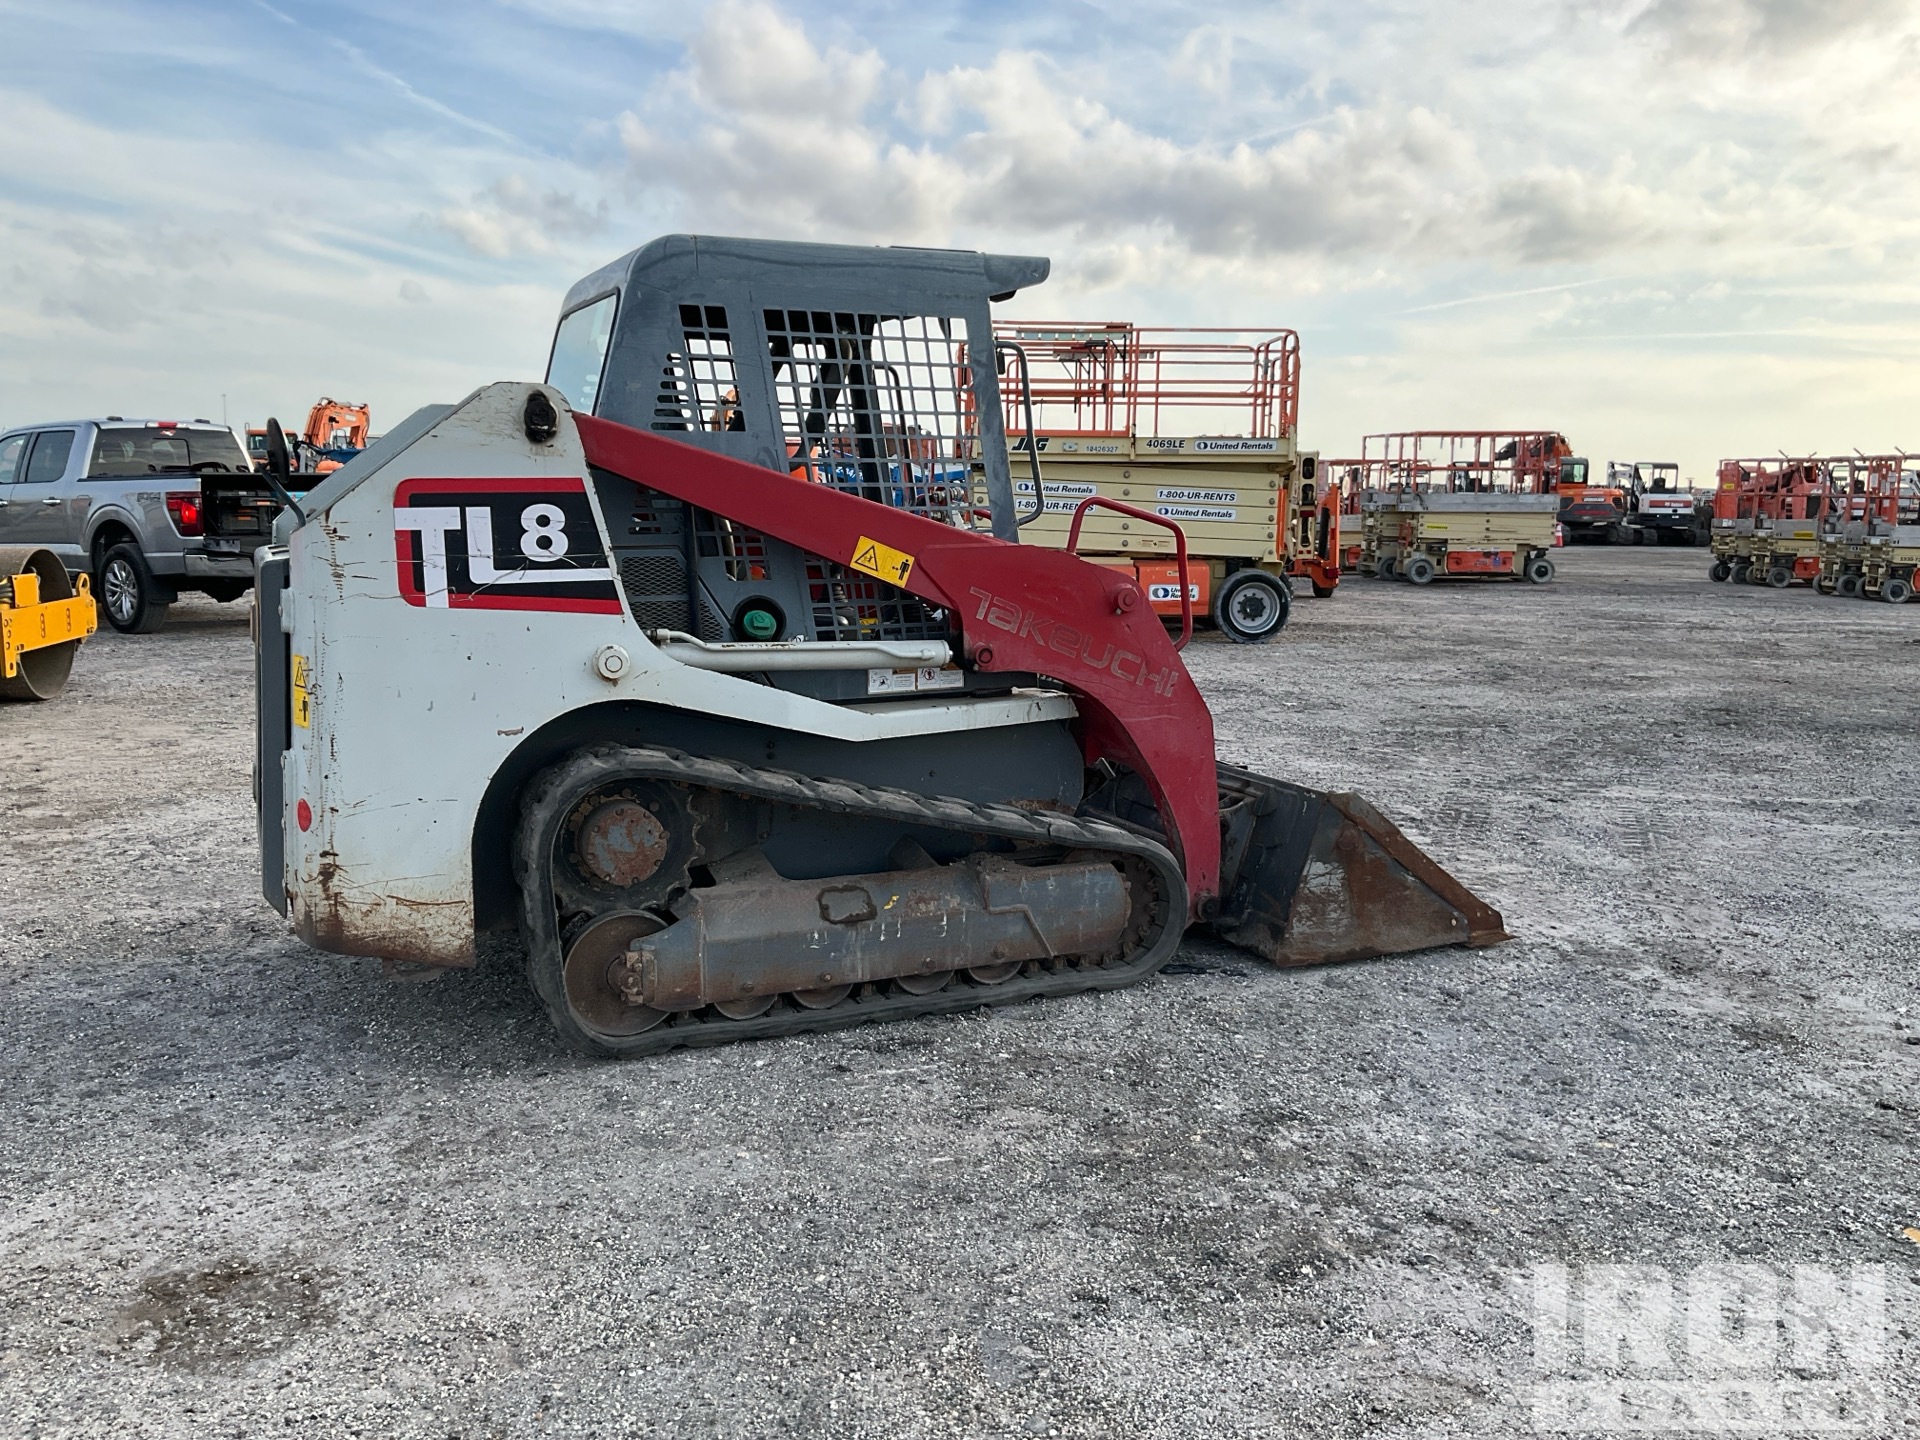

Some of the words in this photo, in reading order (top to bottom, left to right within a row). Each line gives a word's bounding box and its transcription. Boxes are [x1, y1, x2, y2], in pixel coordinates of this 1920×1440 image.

[1146, 439, 1186, 449] 4069LE
[1209, 441, 1239, 450] United
[1241, 441, 1273, 450] Rentals
[1030, 484, 1060, 493] Uited
[1061, 485, 1093, 494] Rentals
[1158, 490, 1236, 502] 1-800-UR-RENTS
[1170, 508, 1200, 518] United
[1201, 509, 1233, 518] Rentals
[393, 503, 612, 608] TL8
